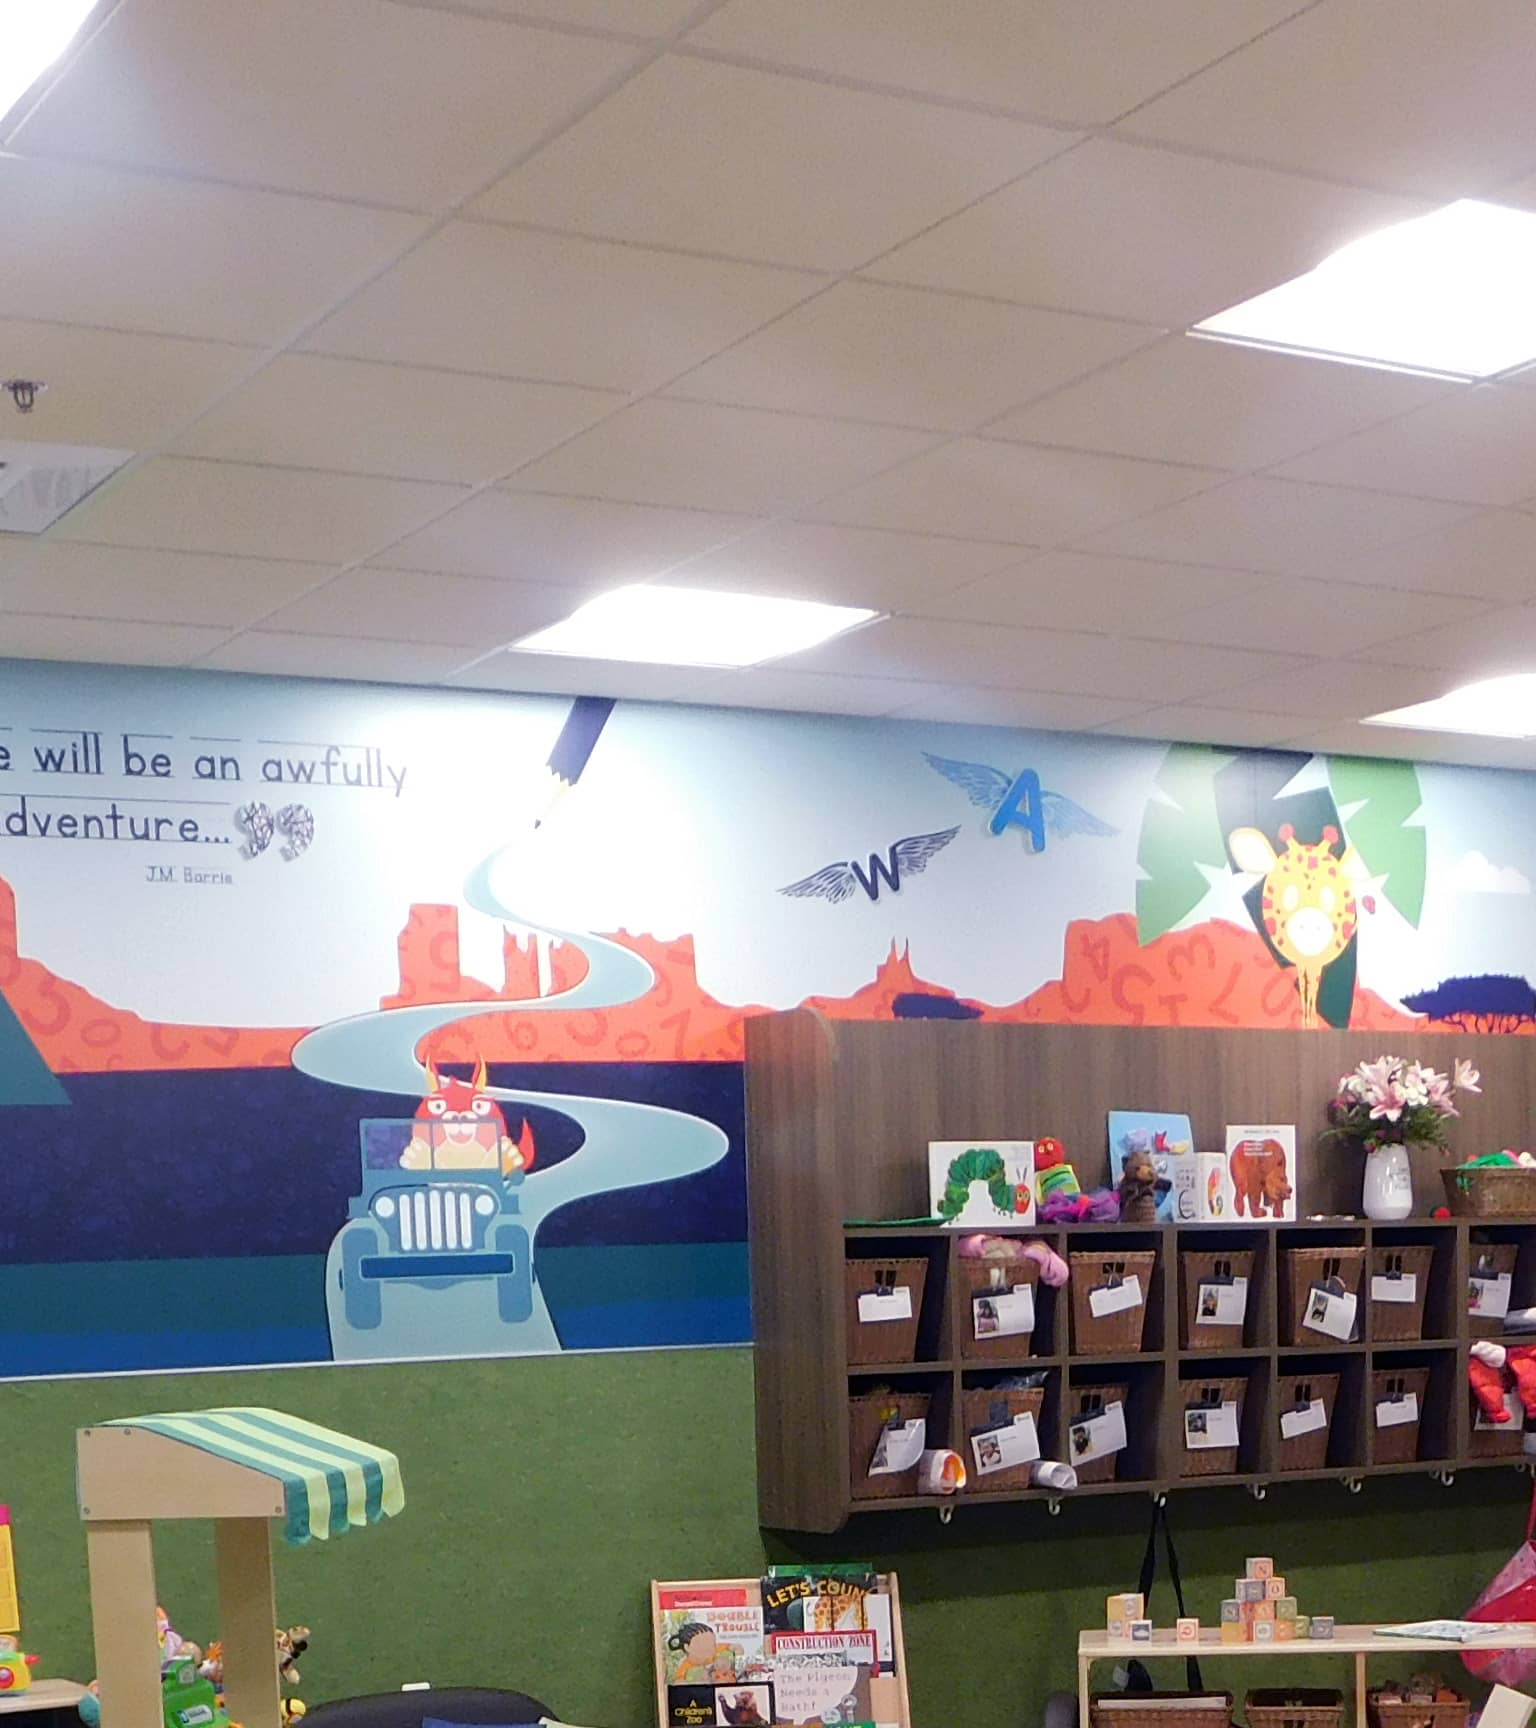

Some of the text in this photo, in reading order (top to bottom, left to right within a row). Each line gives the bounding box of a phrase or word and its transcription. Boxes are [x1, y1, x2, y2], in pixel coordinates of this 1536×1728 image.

[33, 731, 102, 775] will
[122, 734, 173, 777] be
[194, 754, 241, 780] an
[262, 745, 408, 798] awfully
[183, 866, 234, 886] Barrie
[767, 1580, 812, 1608] LET'S
[706, 1611, 758, 1622] DOUBLE
[714, 1623, 760, 1633] TROUBLE
[777, 1634, 872, 1650] CONSTRUCTION ZONE
[690, 1699, 697, 1708] A
